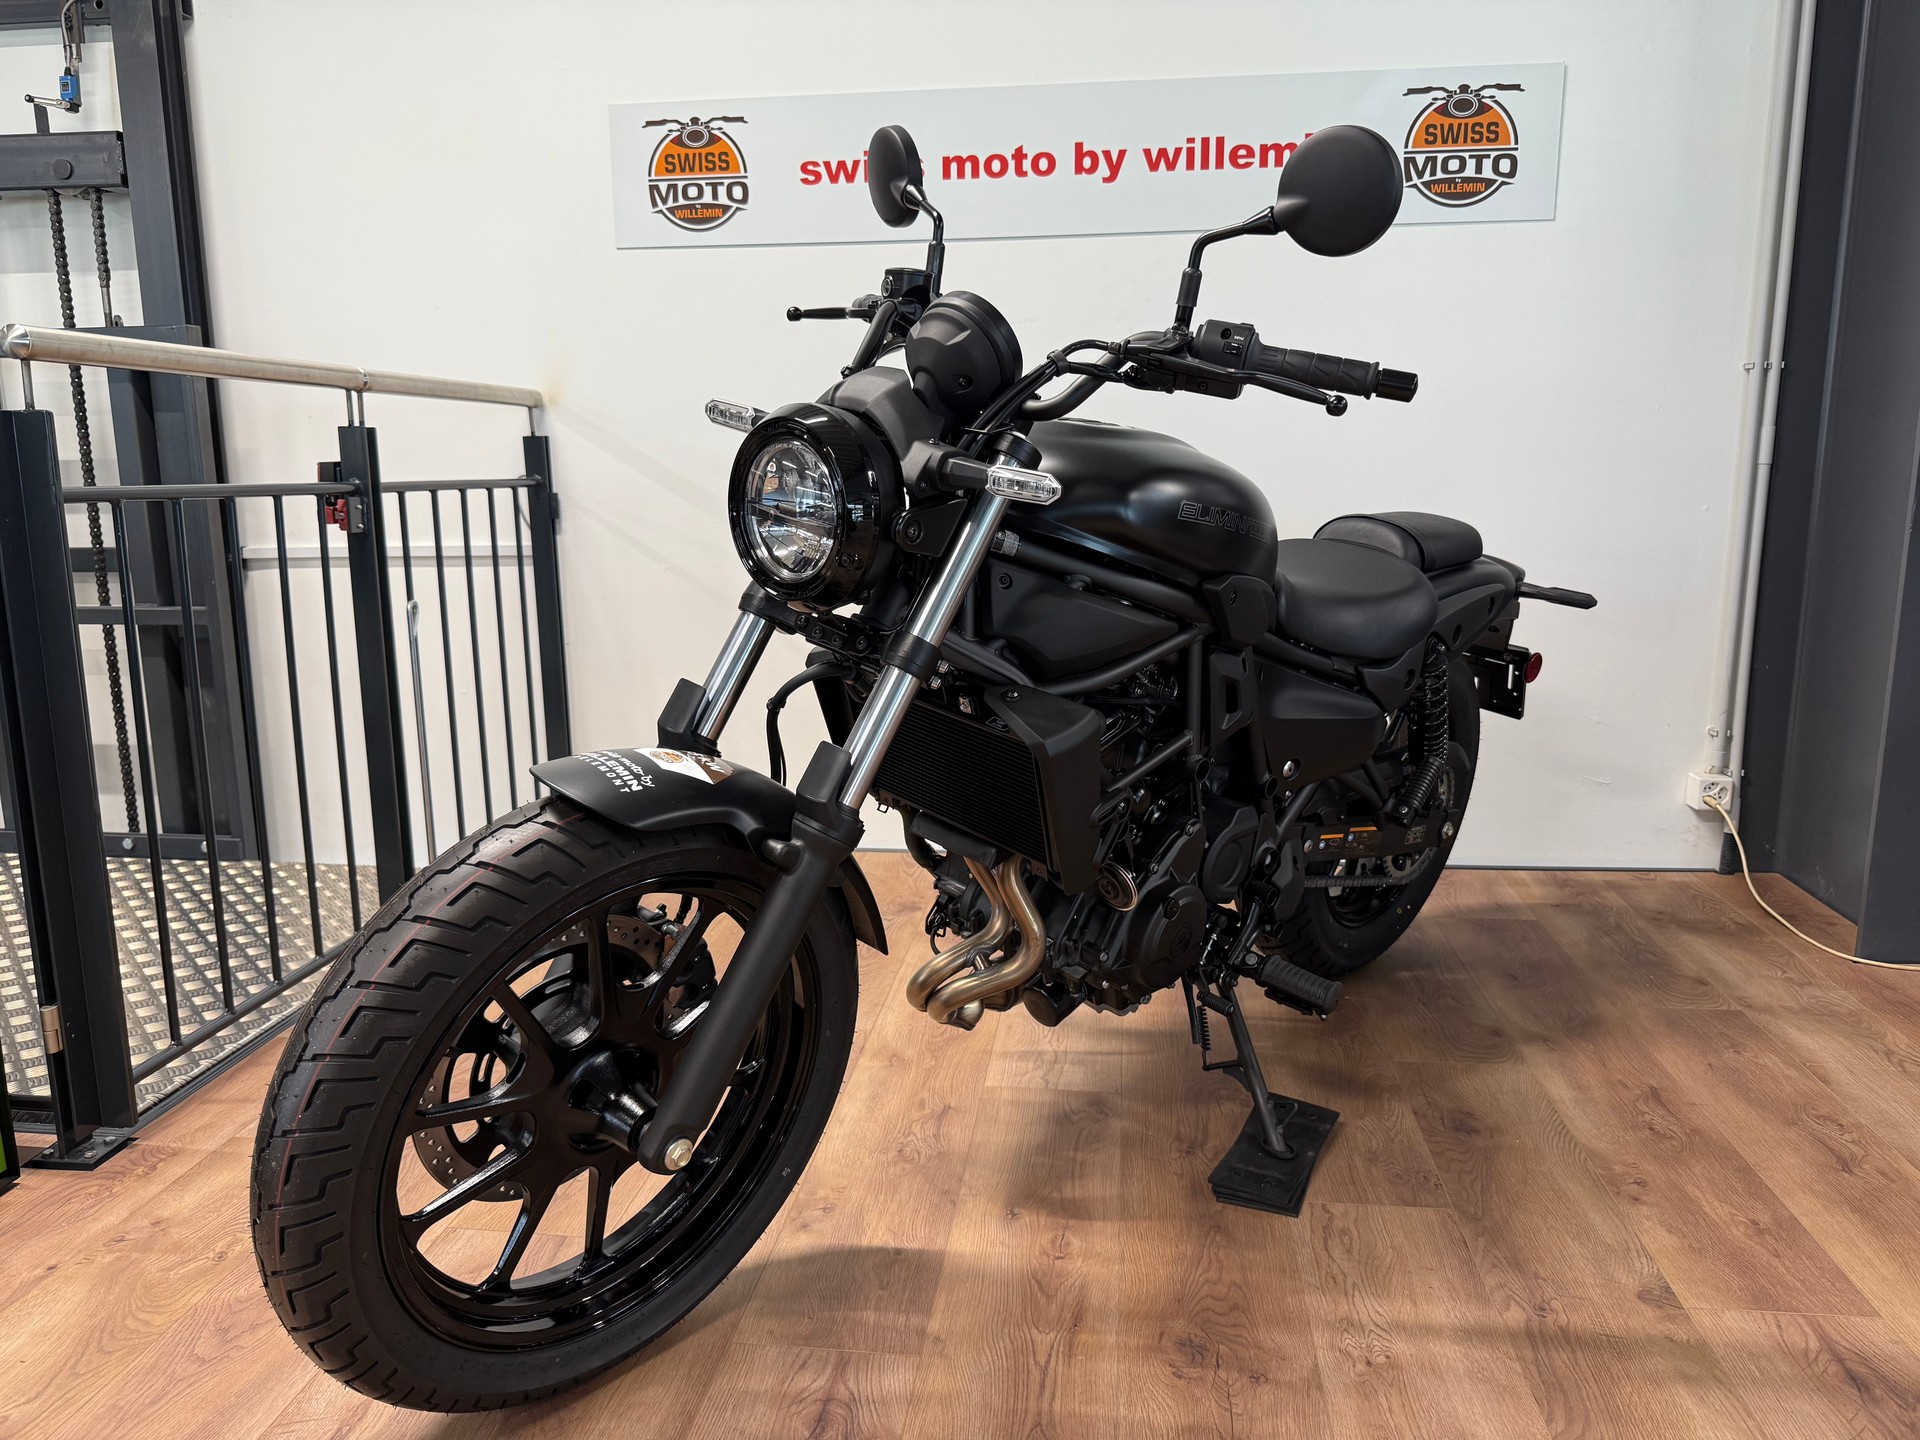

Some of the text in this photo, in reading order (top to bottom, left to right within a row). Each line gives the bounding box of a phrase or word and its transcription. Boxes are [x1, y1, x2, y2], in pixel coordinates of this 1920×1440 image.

[1424, 122, 1500, 145] SWISS
[664, 151, 730, 174] SWISS
[800, 133, 1314, 186] swi moto by willem
[1403, 153, 1518, 183] MOTO
[648, 181, 749, 209] MOTO
[1431, 183, 1486, 194] WILLEMIN
[675, 208, 723, 219] WILLEMIN
[1178, 500, 1271, 544] ELIMIN
[641, 774, 656, 787] by
